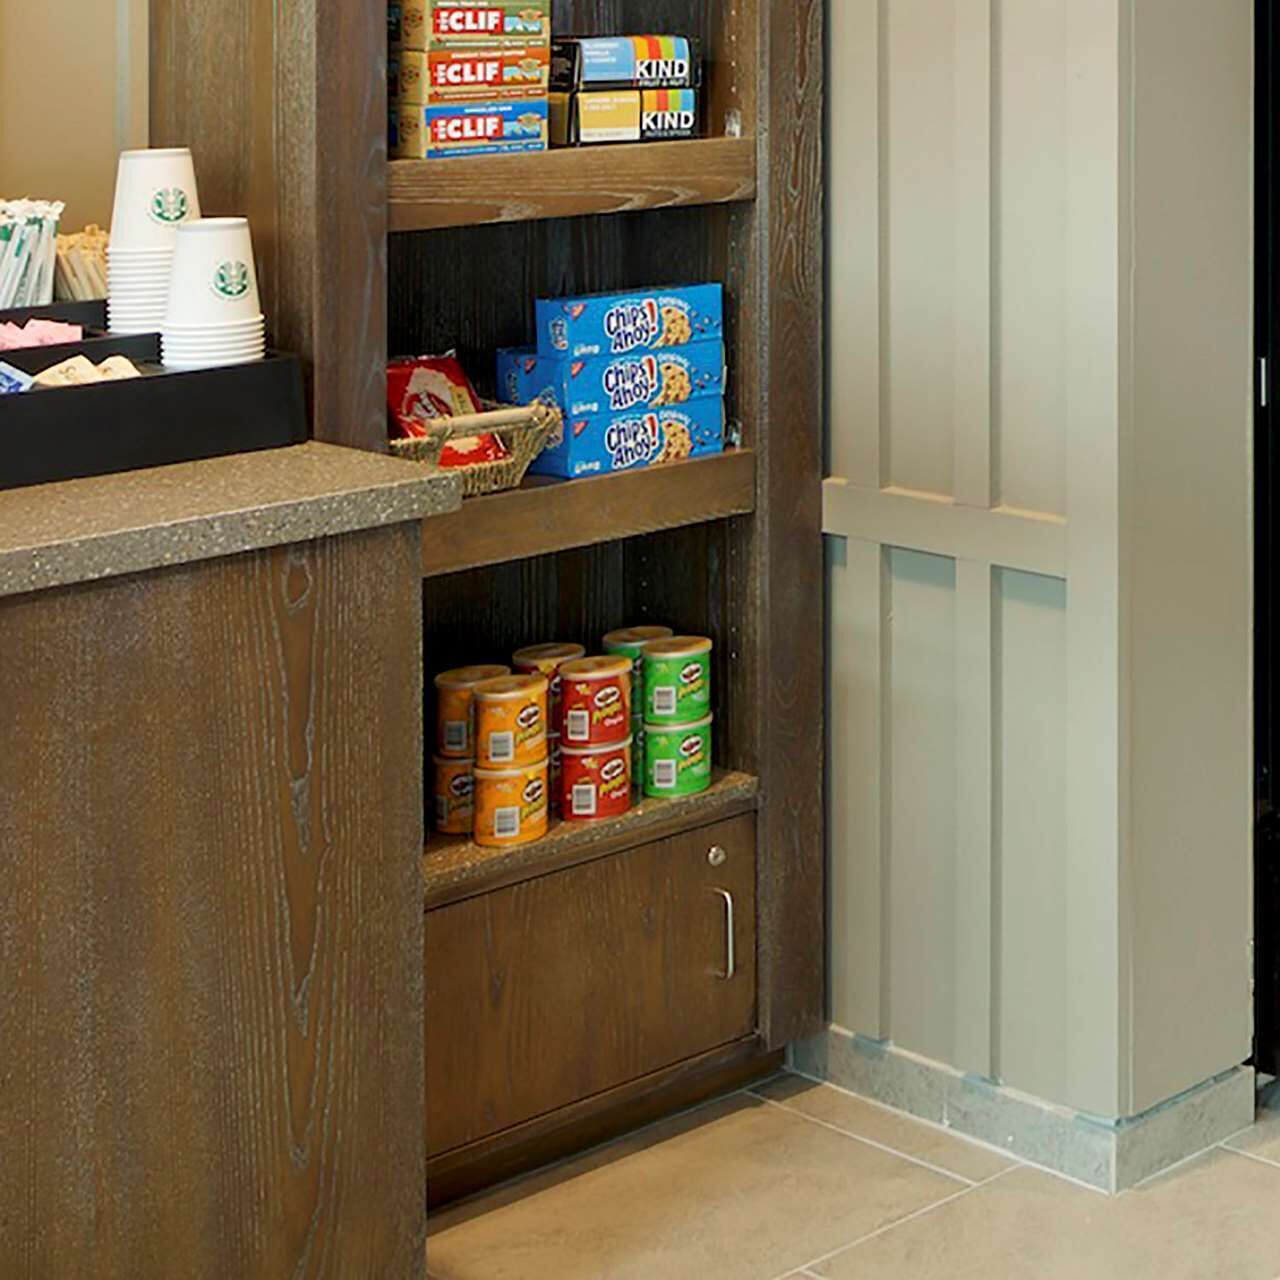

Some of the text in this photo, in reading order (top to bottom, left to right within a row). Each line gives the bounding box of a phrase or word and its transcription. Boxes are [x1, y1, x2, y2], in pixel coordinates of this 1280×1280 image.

[449, 10, 501, 31] CLIF
[446, 63, 499, 84] CLIF
[636, 59, 689, 78] KIND
[447, 116, 499, 139] CLIF
[642, 111, 695, 130] KIND
[605, 305, 648, 336] Chips
[604, 361, 647, 393] Chips
[606, 420, 649, 452] Chips
